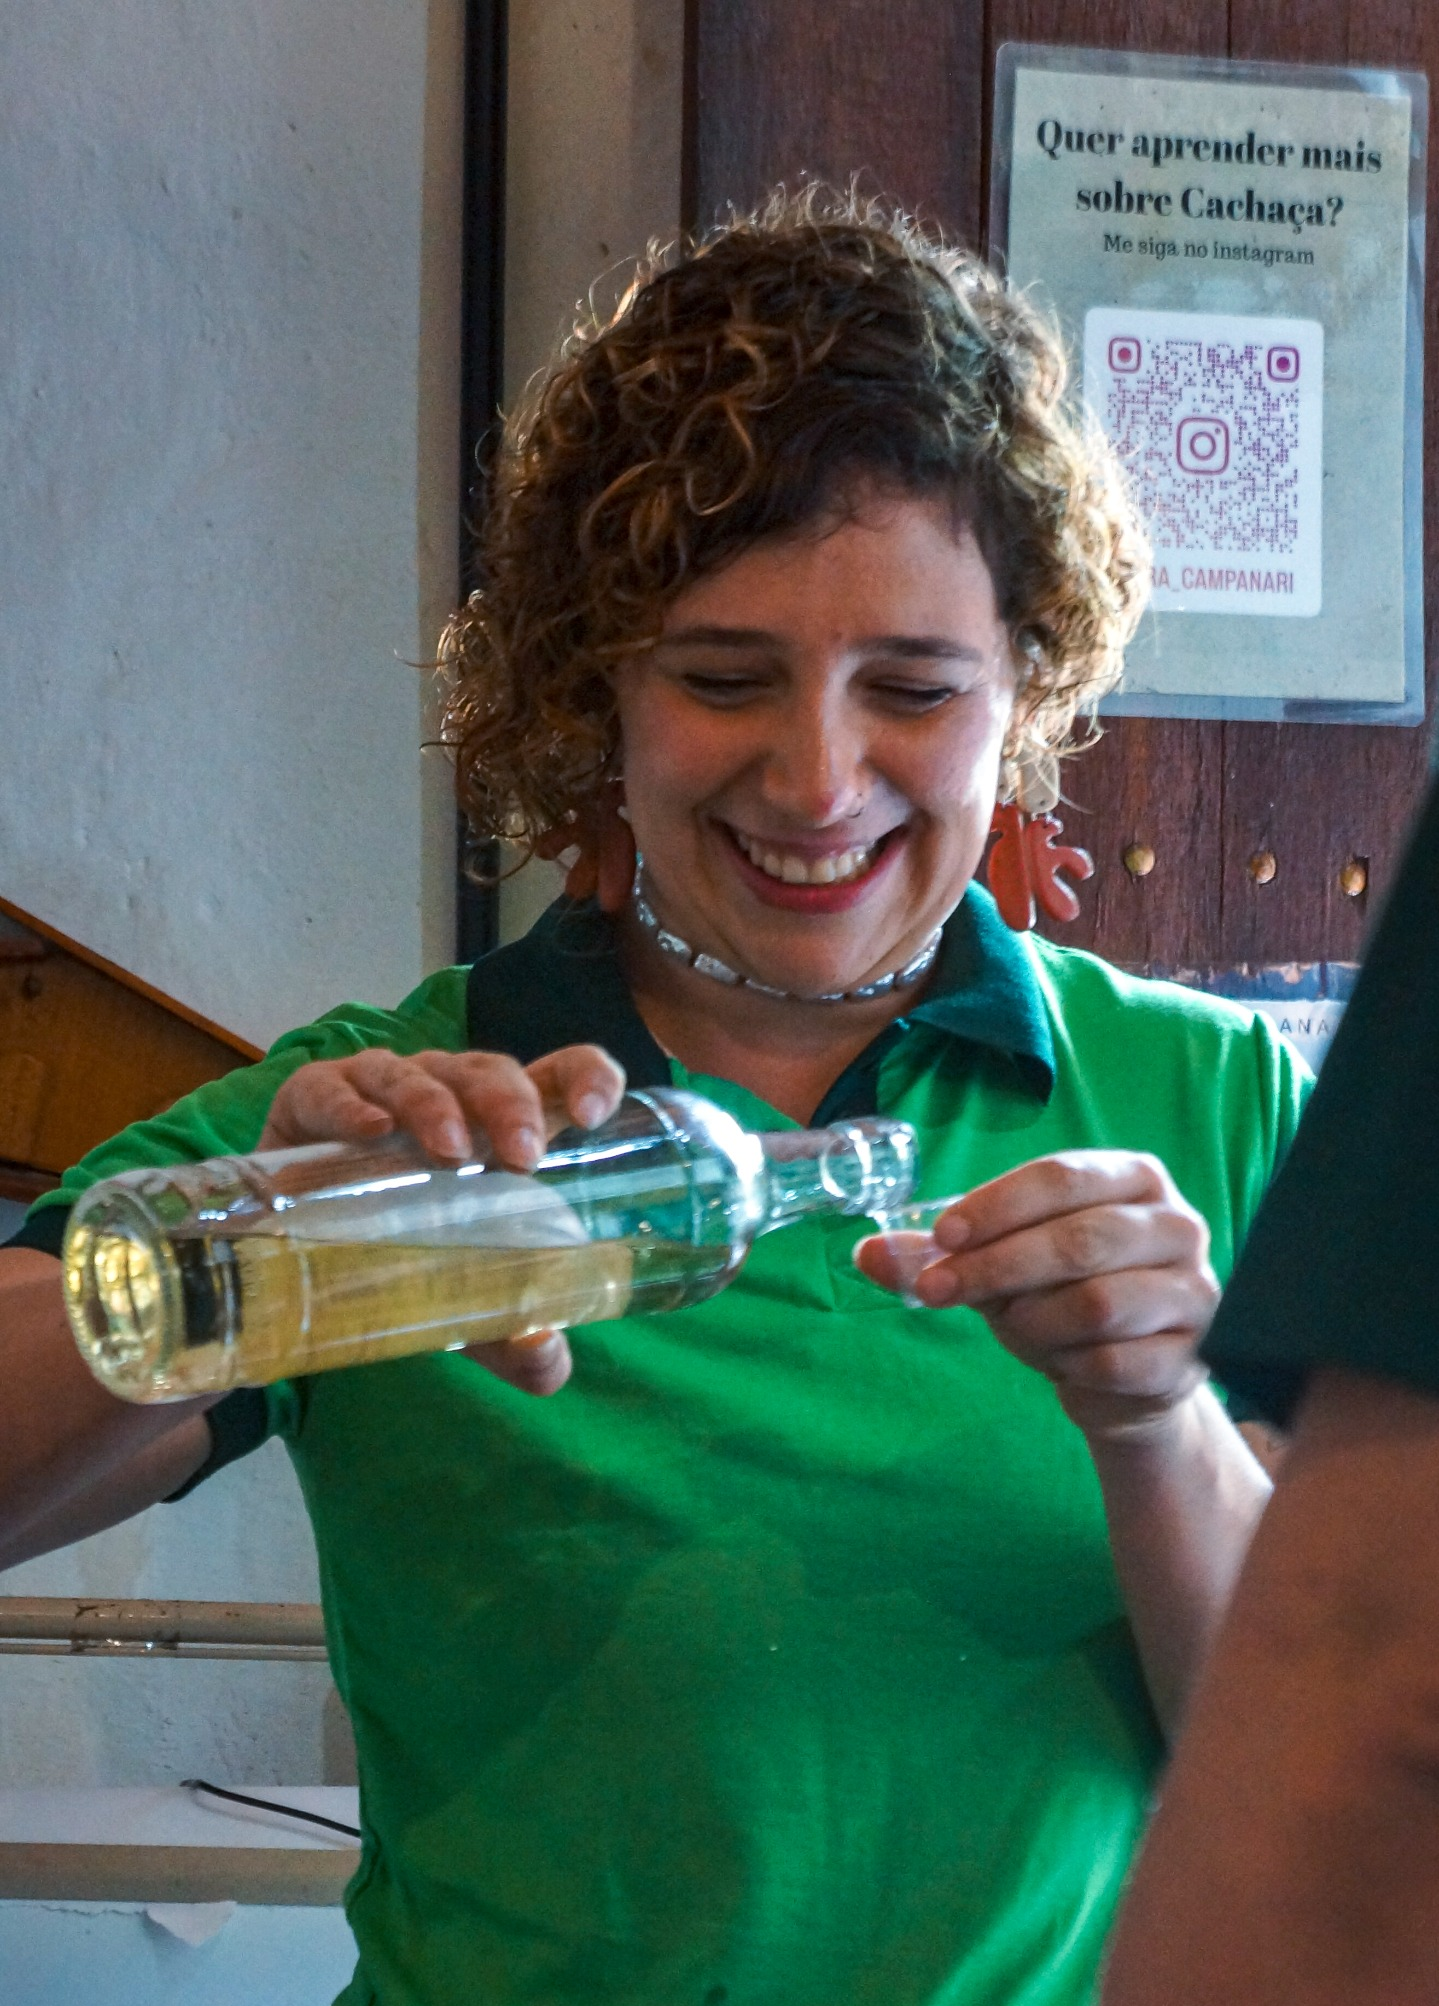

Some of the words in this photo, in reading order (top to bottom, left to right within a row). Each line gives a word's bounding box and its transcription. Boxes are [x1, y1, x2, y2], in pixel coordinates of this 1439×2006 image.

[1036, 119, 1125, 161] Quer
[1131, 131, 1295, 169] aprender
[1301, 141, 1383, 173] mais
[1076, 181, 1173, 217] sobre
[1180, 186, 1344, 234] Cachaça?
[1103, 234, 1133, 255] Me
[1138, 239, 1179, 261] siga
[1183, 244, 1209, 259] no
[1213, 241, 1315, 268] instagram
